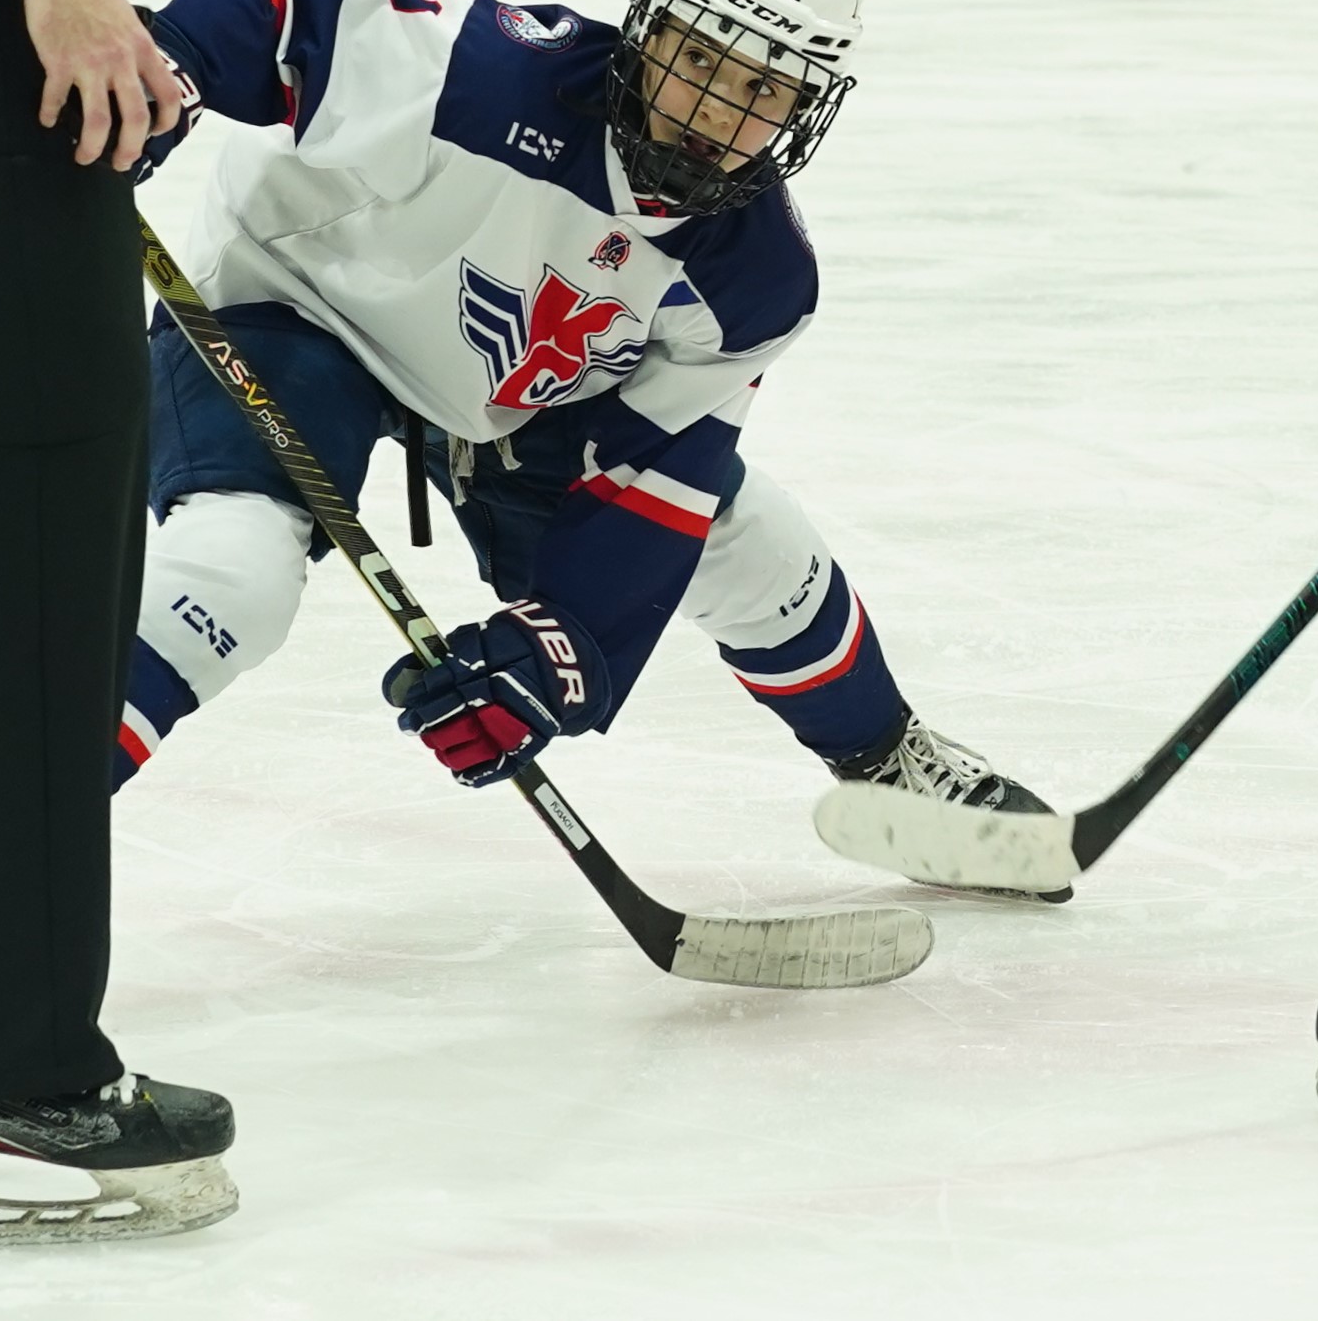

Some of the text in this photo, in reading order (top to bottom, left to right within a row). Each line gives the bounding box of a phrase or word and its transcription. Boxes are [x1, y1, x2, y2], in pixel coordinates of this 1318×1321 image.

[257, 408, 290, 449] PRO
[359, 550, 452, 669] CC
[503, 598, 586, 707] UER
